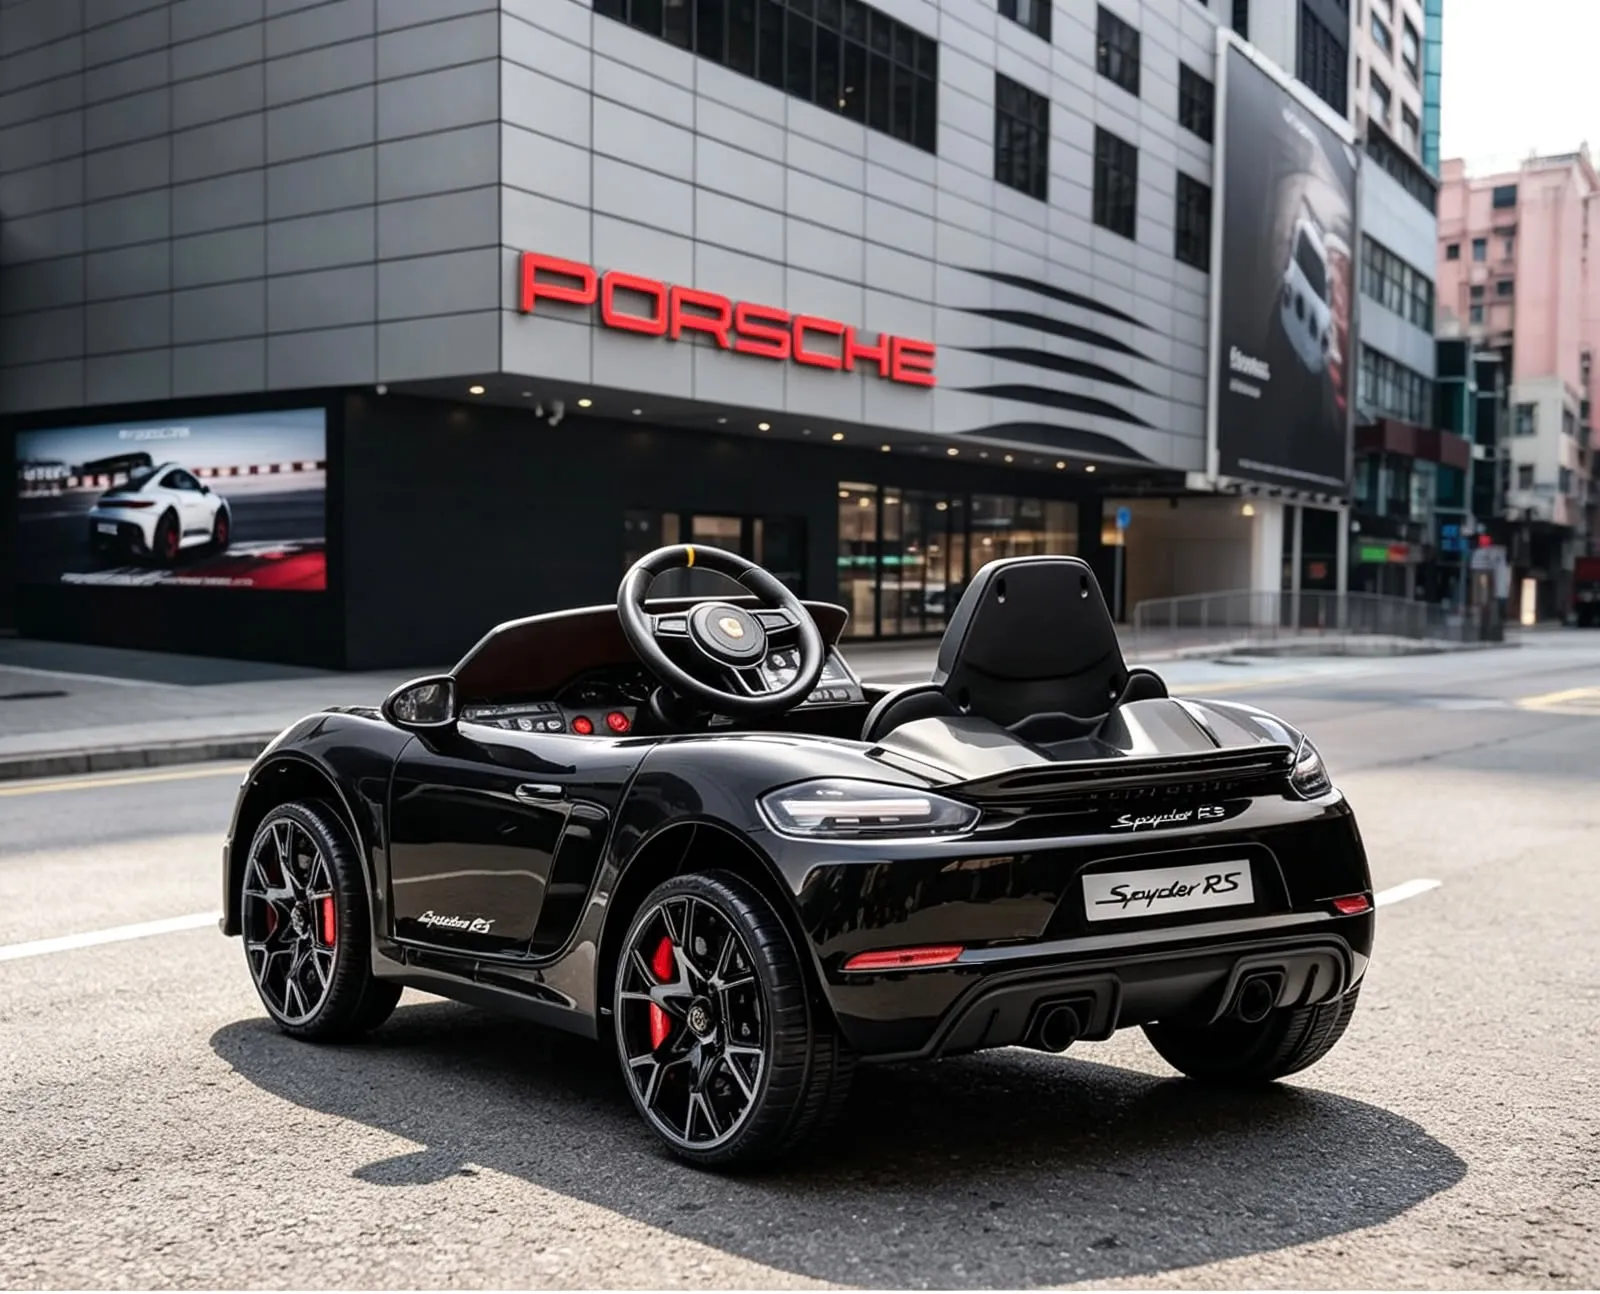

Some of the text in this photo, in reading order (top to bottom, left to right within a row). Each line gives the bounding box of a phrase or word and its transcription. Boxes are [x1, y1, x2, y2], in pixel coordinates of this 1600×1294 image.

[519, 251, 937, 388] PORSCHE
[1094, 871, 1243, 910] Spyder RS
